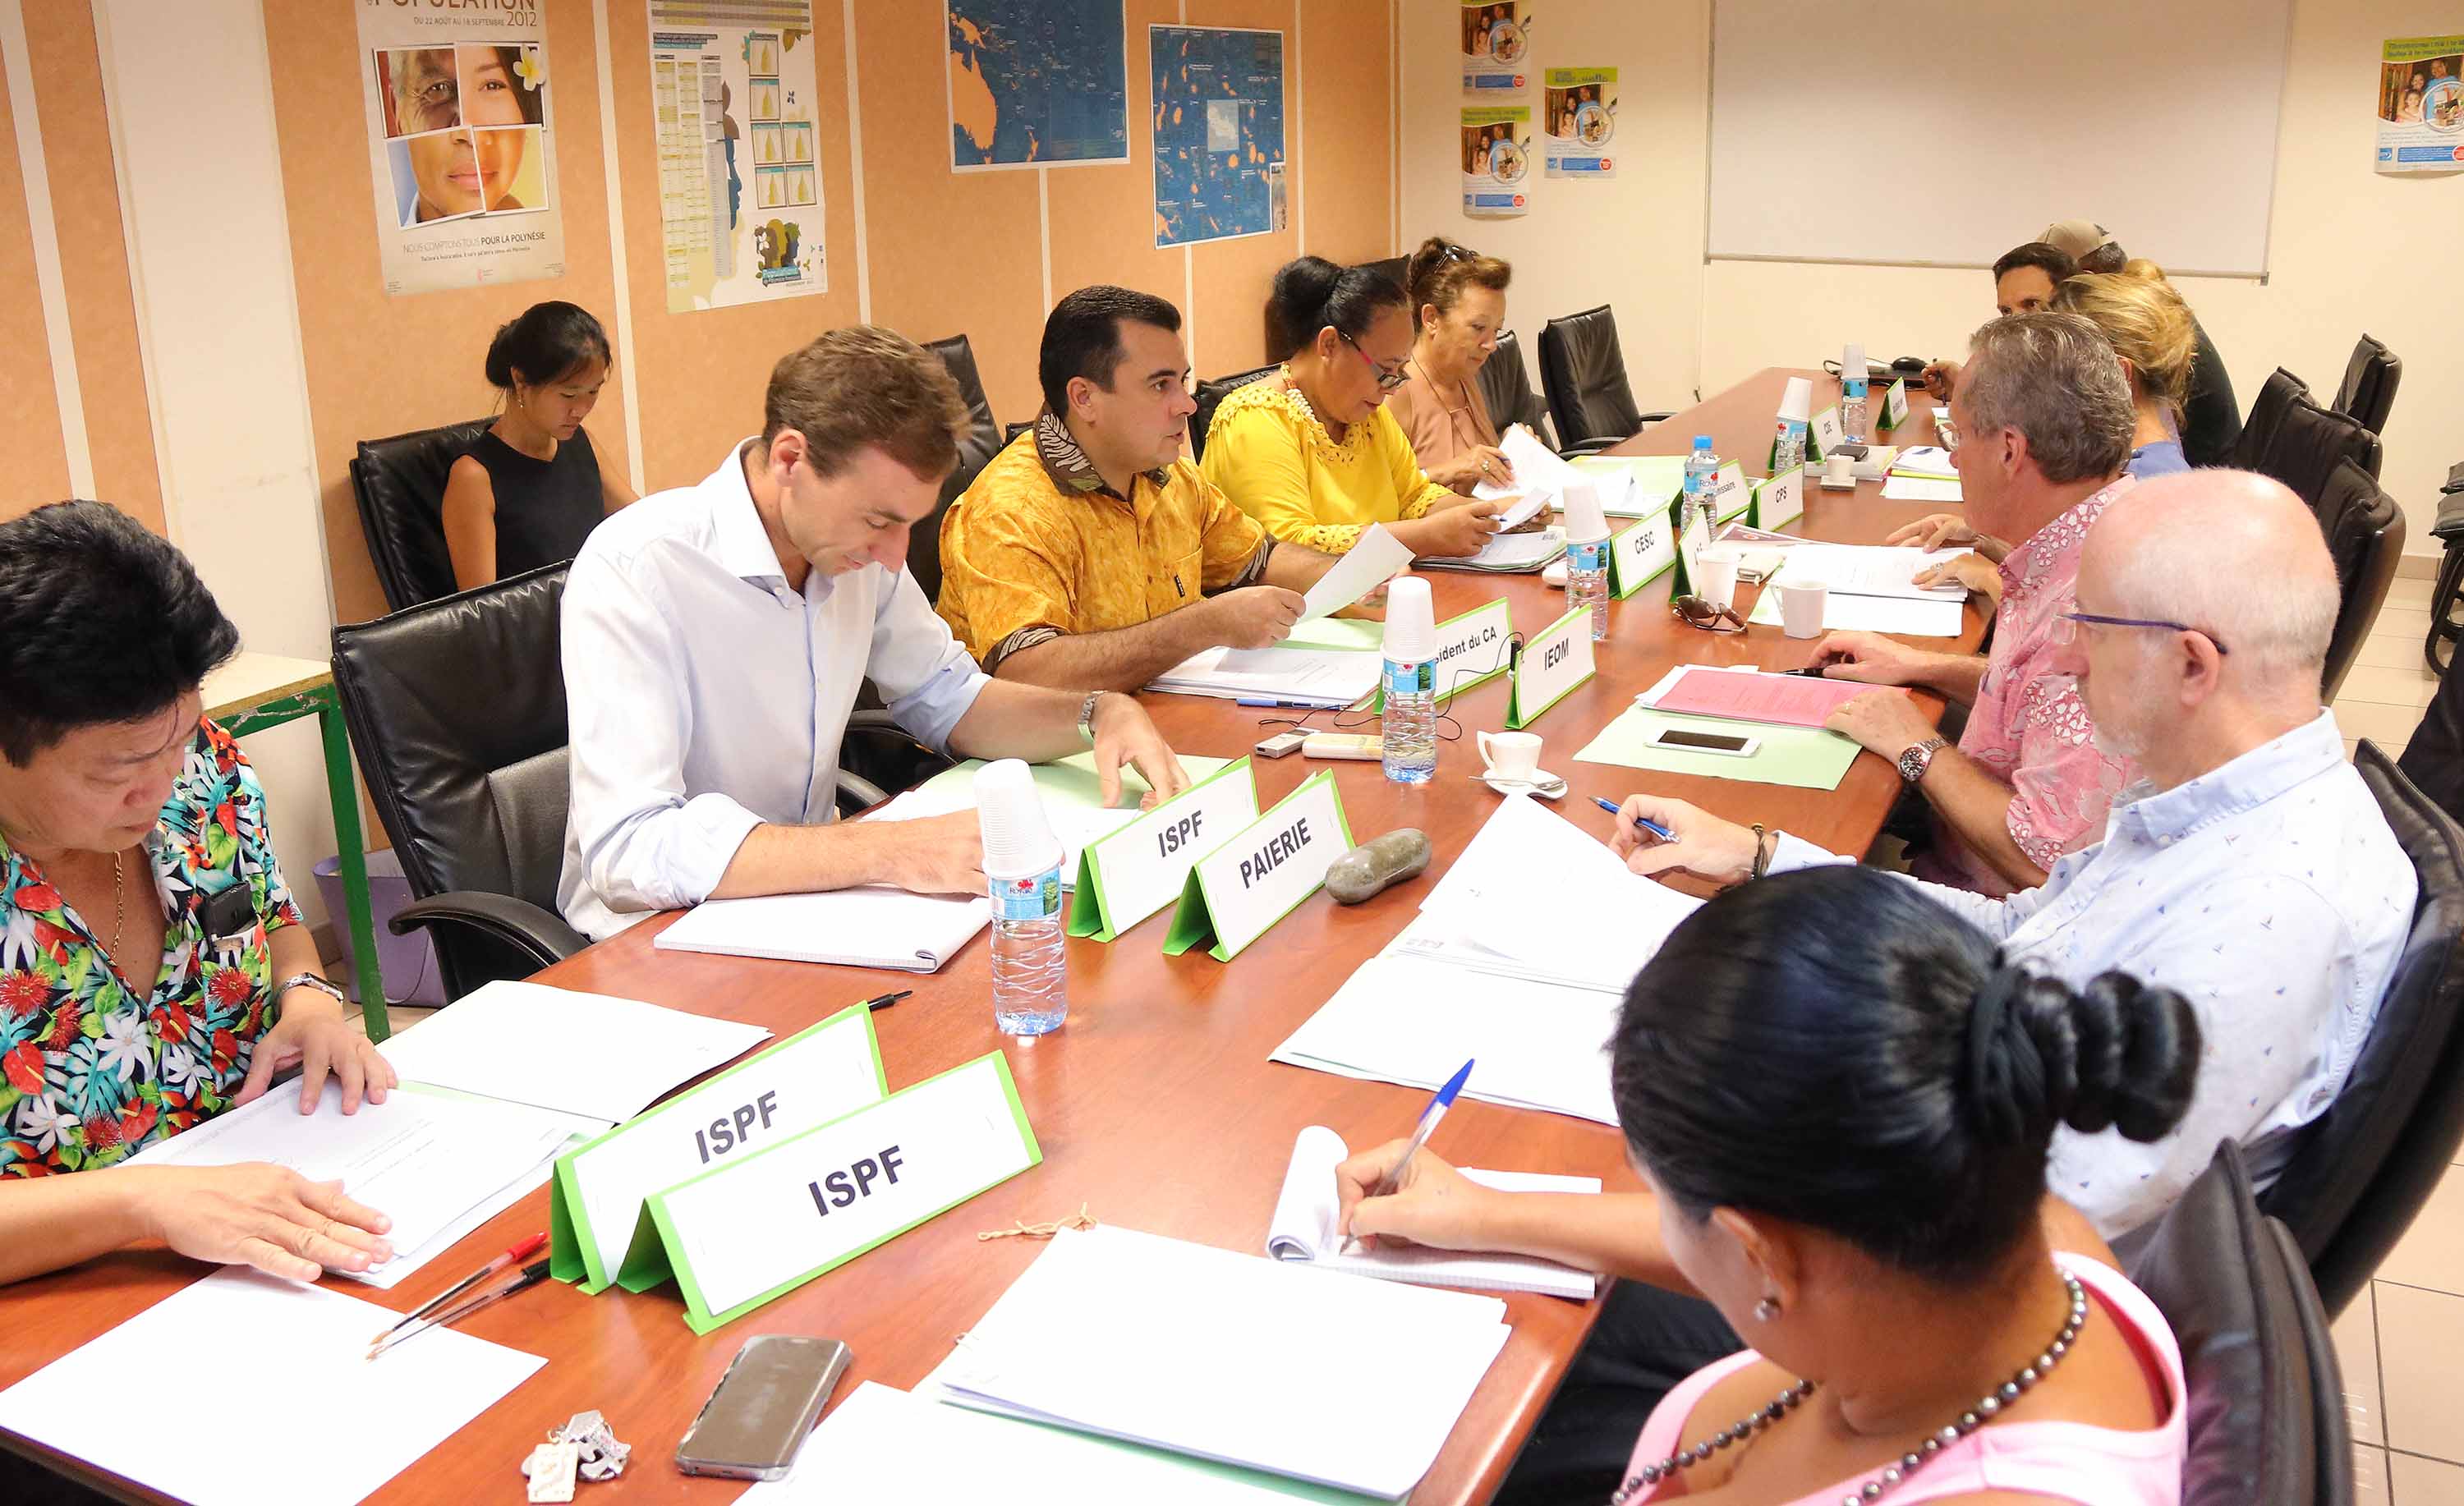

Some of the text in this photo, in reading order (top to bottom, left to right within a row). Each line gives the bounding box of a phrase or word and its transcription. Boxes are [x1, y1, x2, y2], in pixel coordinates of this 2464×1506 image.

[507, 11, 537, 26] 2012
[480, 236, 501, 245] POUR
[502, 235, 510, 244] LA
[511, 232, 546, 243] POLYNÉSIE
[1776, 485, 1787, 503] CPS
[1635, 531, 1654, 554] CESC
[1469, 635, 1481, 650] du
[1483, 626, 1497, 642] CA
[1544, 637, 1569, 671] IEOM
[1158, 810, 1202, 858] ISPF
[1240, 817, 1312, 889] PAIERIE
[695, 1090, 778, 1164] ISPF
[808, 1145, 903, 1217] ISPF
